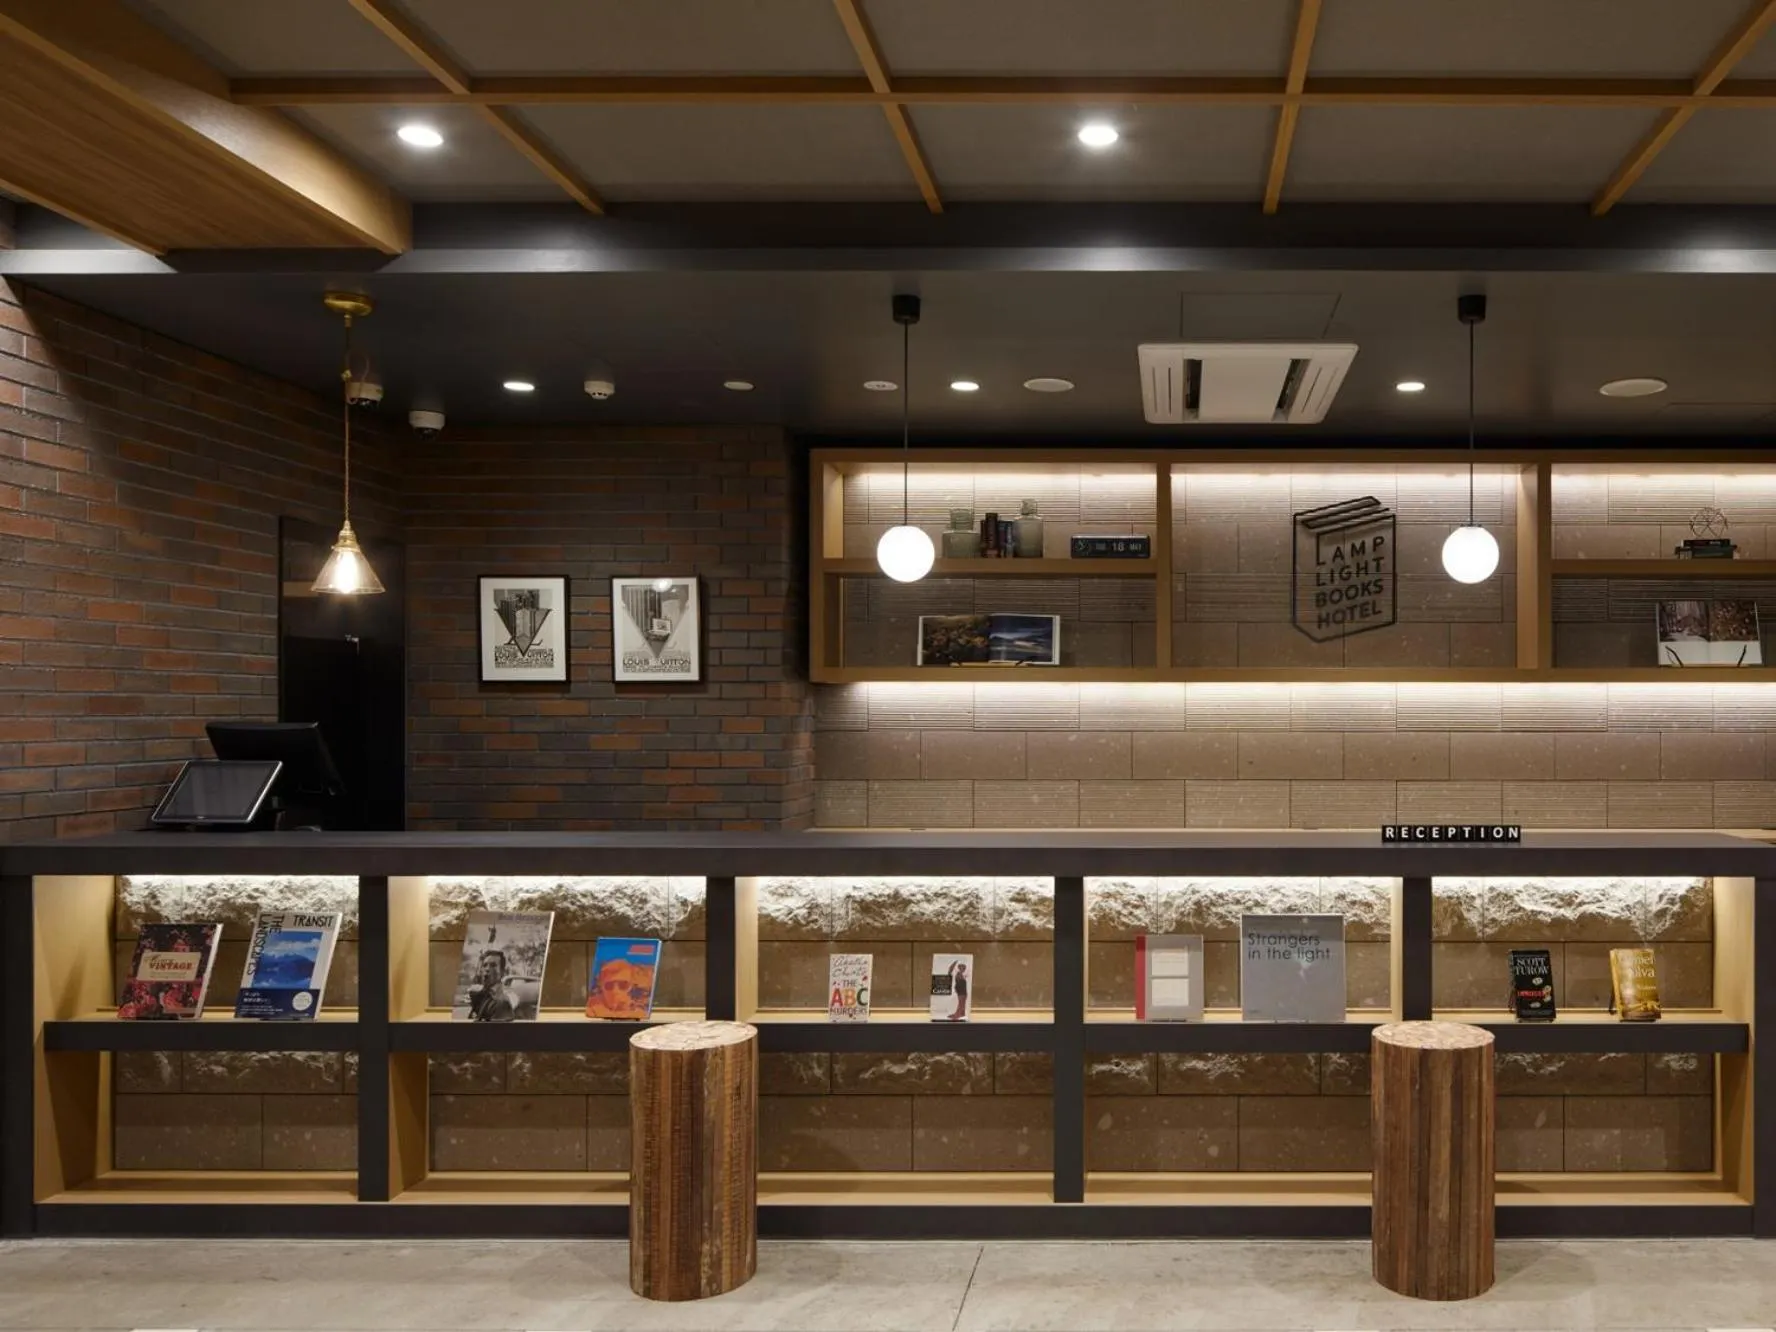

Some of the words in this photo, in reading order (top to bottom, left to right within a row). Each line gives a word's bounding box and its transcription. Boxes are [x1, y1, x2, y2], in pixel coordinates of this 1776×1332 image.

[1316, 535, 1385, 566] LAMP
[1316, 556, 1385, 587] LIGHT
[1315, 578, 1384, 608] BOOKS
[1317, 600, 1383, 630] HOTEL
[1385, 826, 1519, 839] RECEPTION
[268, 913, 285, 934] THE
[293, 914, 334, 927] TRANSIT
[1247, 932, 1321, 949] Strangers
[1247, 947, 1261, 960] in
[1267, 946, 1292, 960] the
[1297, 946, 1331, 963] light
[1516, 957, 1546, 967] SCOTT
[831, 987, 869, 1007] ABC
